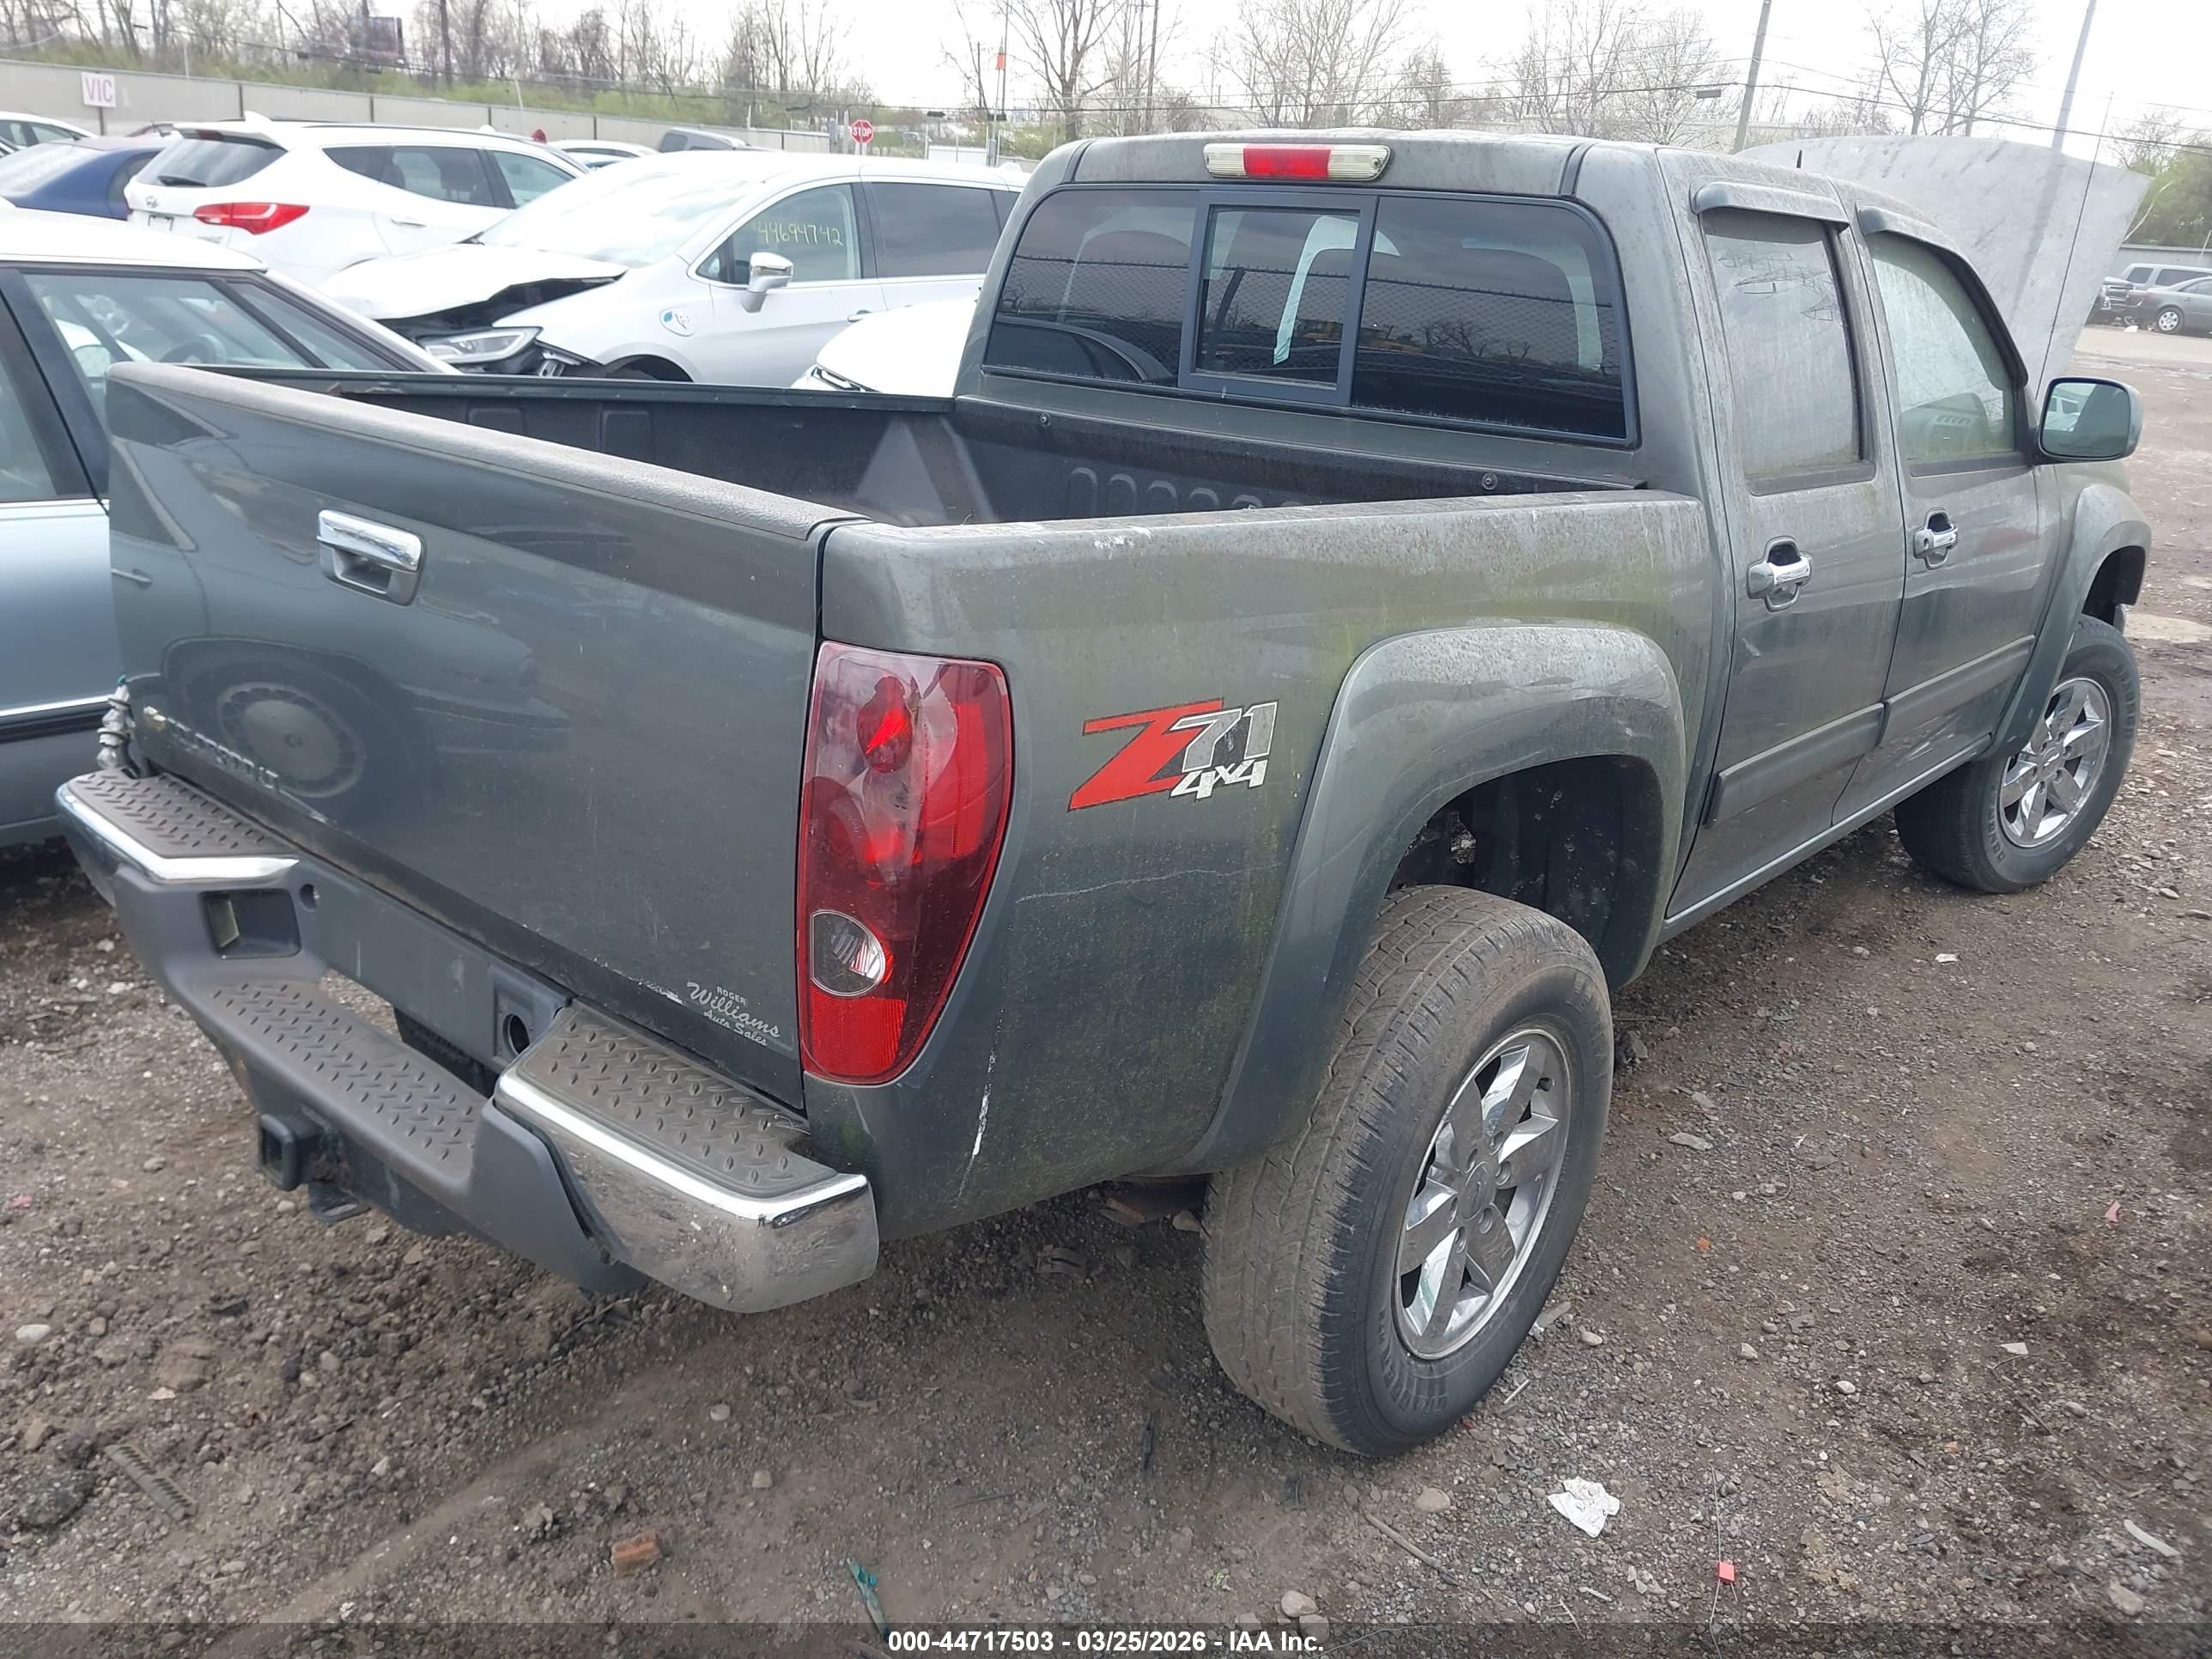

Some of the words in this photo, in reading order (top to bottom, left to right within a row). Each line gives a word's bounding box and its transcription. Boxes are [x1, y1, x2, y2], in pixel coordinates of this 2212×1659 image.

[86, 77, 112, 102] VIC
[853, 127, 872, 137] STOP
[757, 221, 844, 246] 44694742
[1067, 697, 1279, 812] Z71
[1168, 757, 1268, 802] 4x4
[686, 981, 781, 1038] Williams
[717, 986, 747, 1006] ROGER
[703, 1009, 731, 1029] Auto
[733, 1022, 769, 1047] Sales
